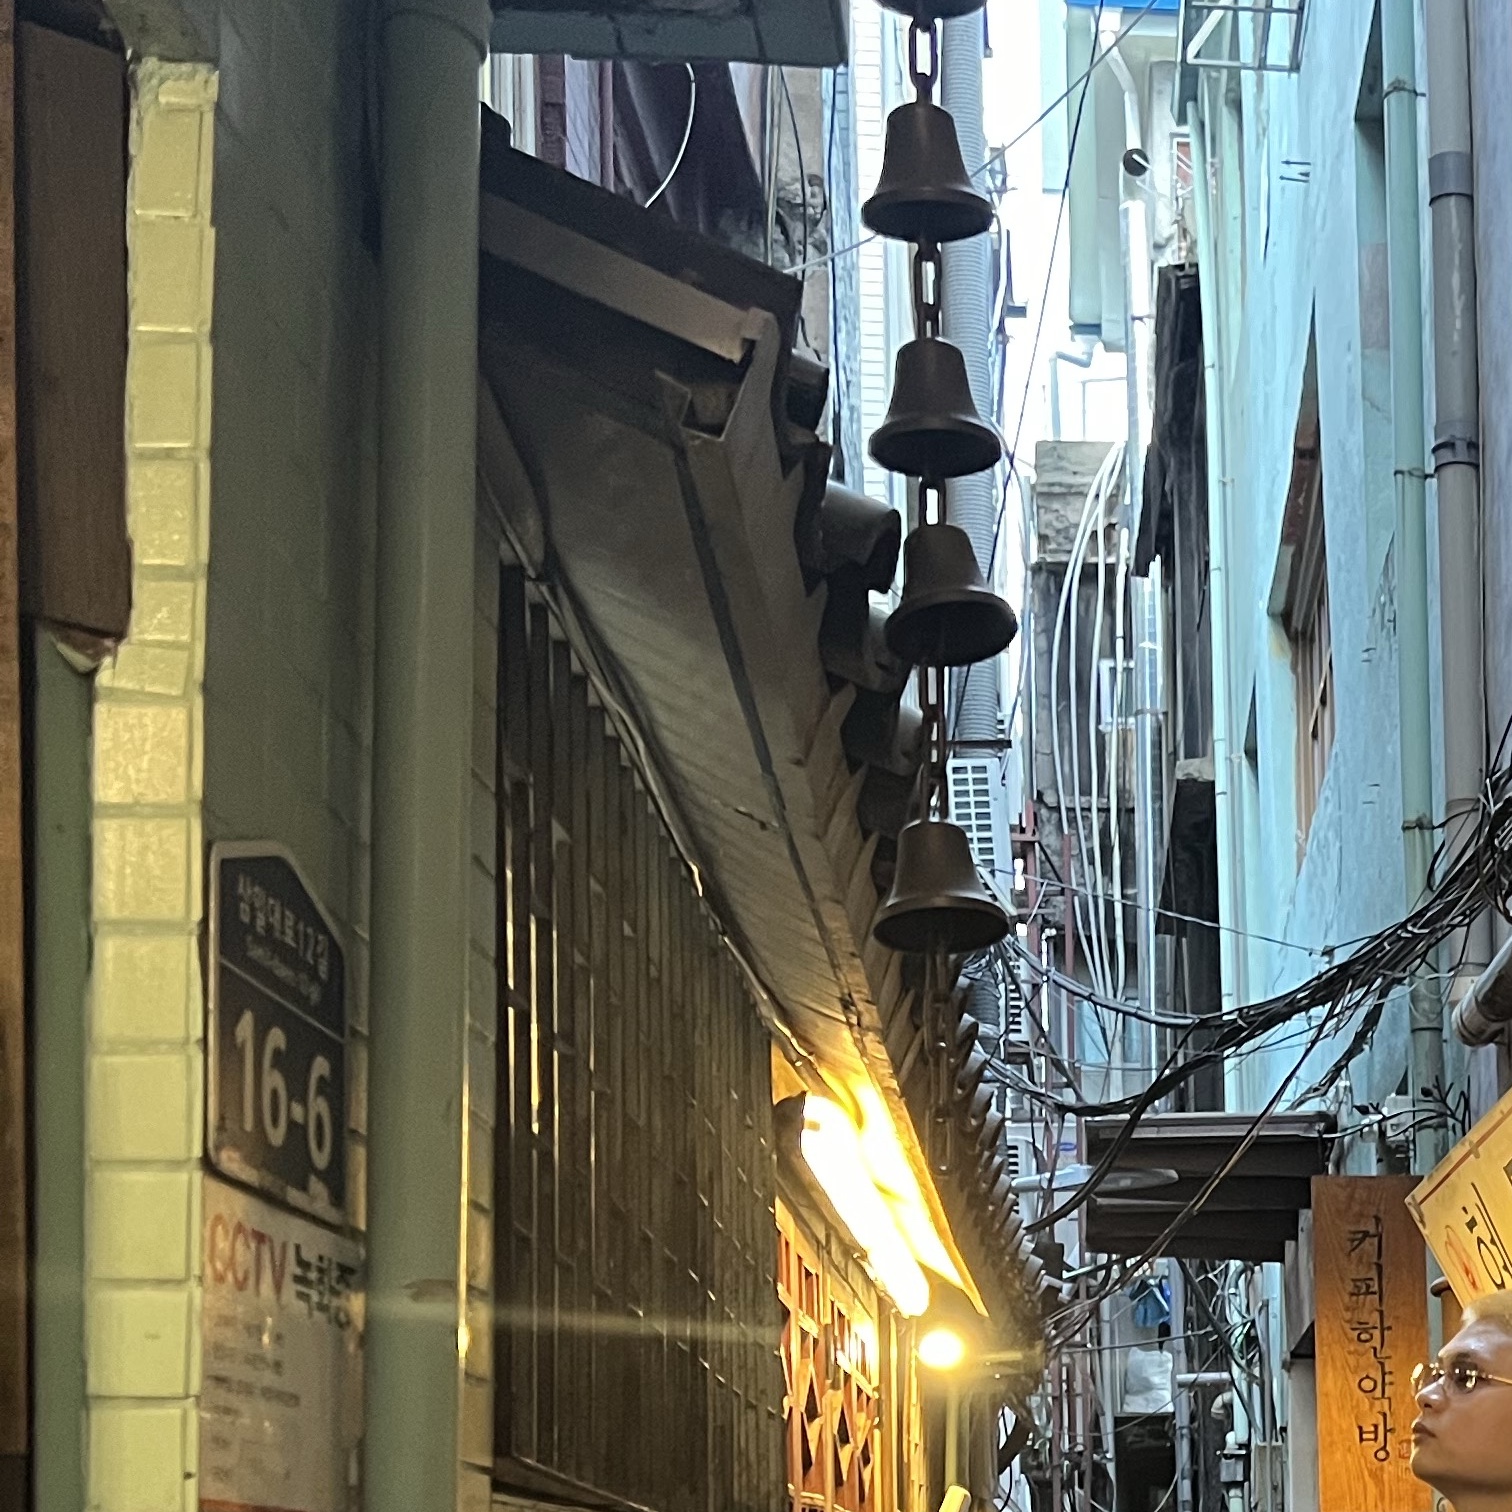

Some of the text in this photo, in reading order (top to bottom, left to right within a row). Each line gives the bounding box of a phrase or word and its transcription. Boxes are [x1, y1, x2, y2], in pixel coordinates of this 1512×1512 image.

[234, 1008, 333, 1172] 16-6
[207, 1212, 288, 1302] CCTV
[1347, 1214, 1398, 1463] 커피한약방
